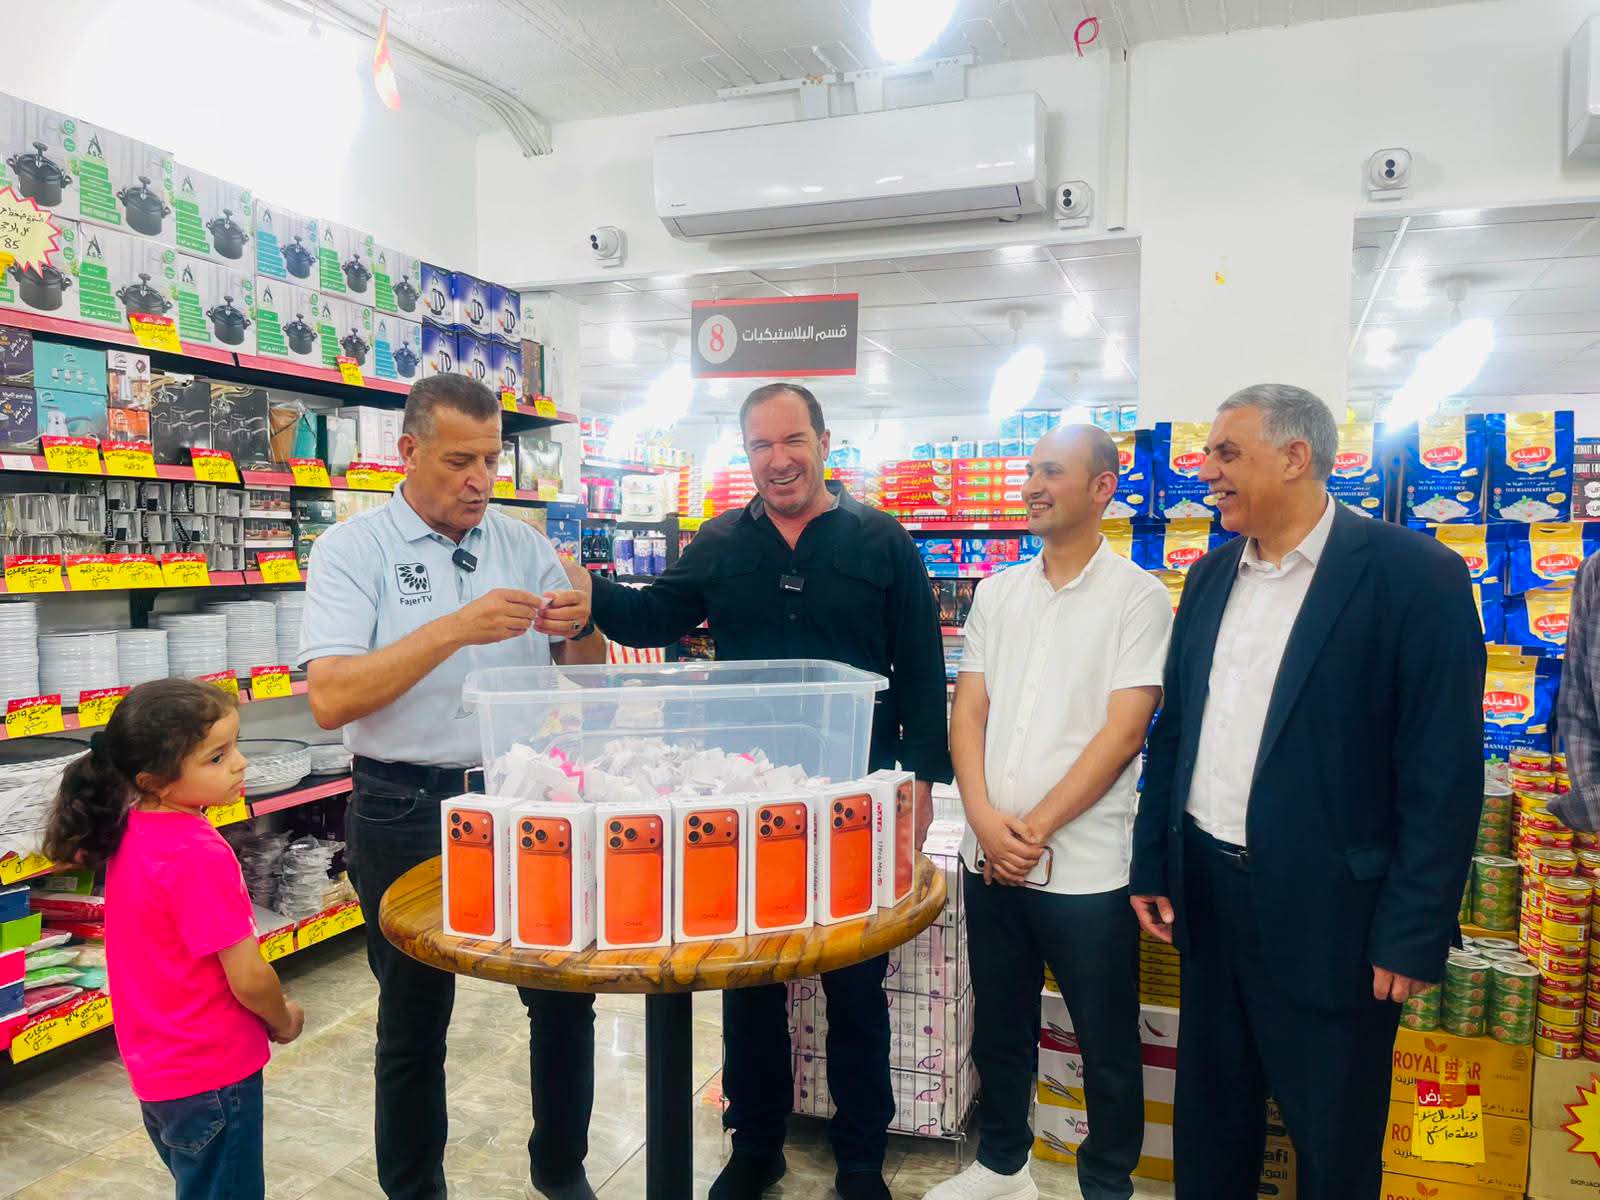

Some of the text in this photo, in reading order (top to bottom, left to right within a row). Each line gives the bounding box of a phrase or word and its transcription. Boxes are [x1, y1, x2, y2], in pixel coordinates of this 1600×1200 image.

[709, 323, 725, 352] 8
[742, 324, 847, 344] قسم البلاستيكيات
[17, 556, 34, 565] خاص
[19, 697, 48, 708] عرض خاص
[90, 689, 120, 699] عرض خاص
[71, 992, 99, 1010] عرض خاص
[22, 1013, 52, 1031] عرض خاص
[1393, 1050, 1440, 1074] ROYAL
[1418, 1089, 1442, 1105] رض
